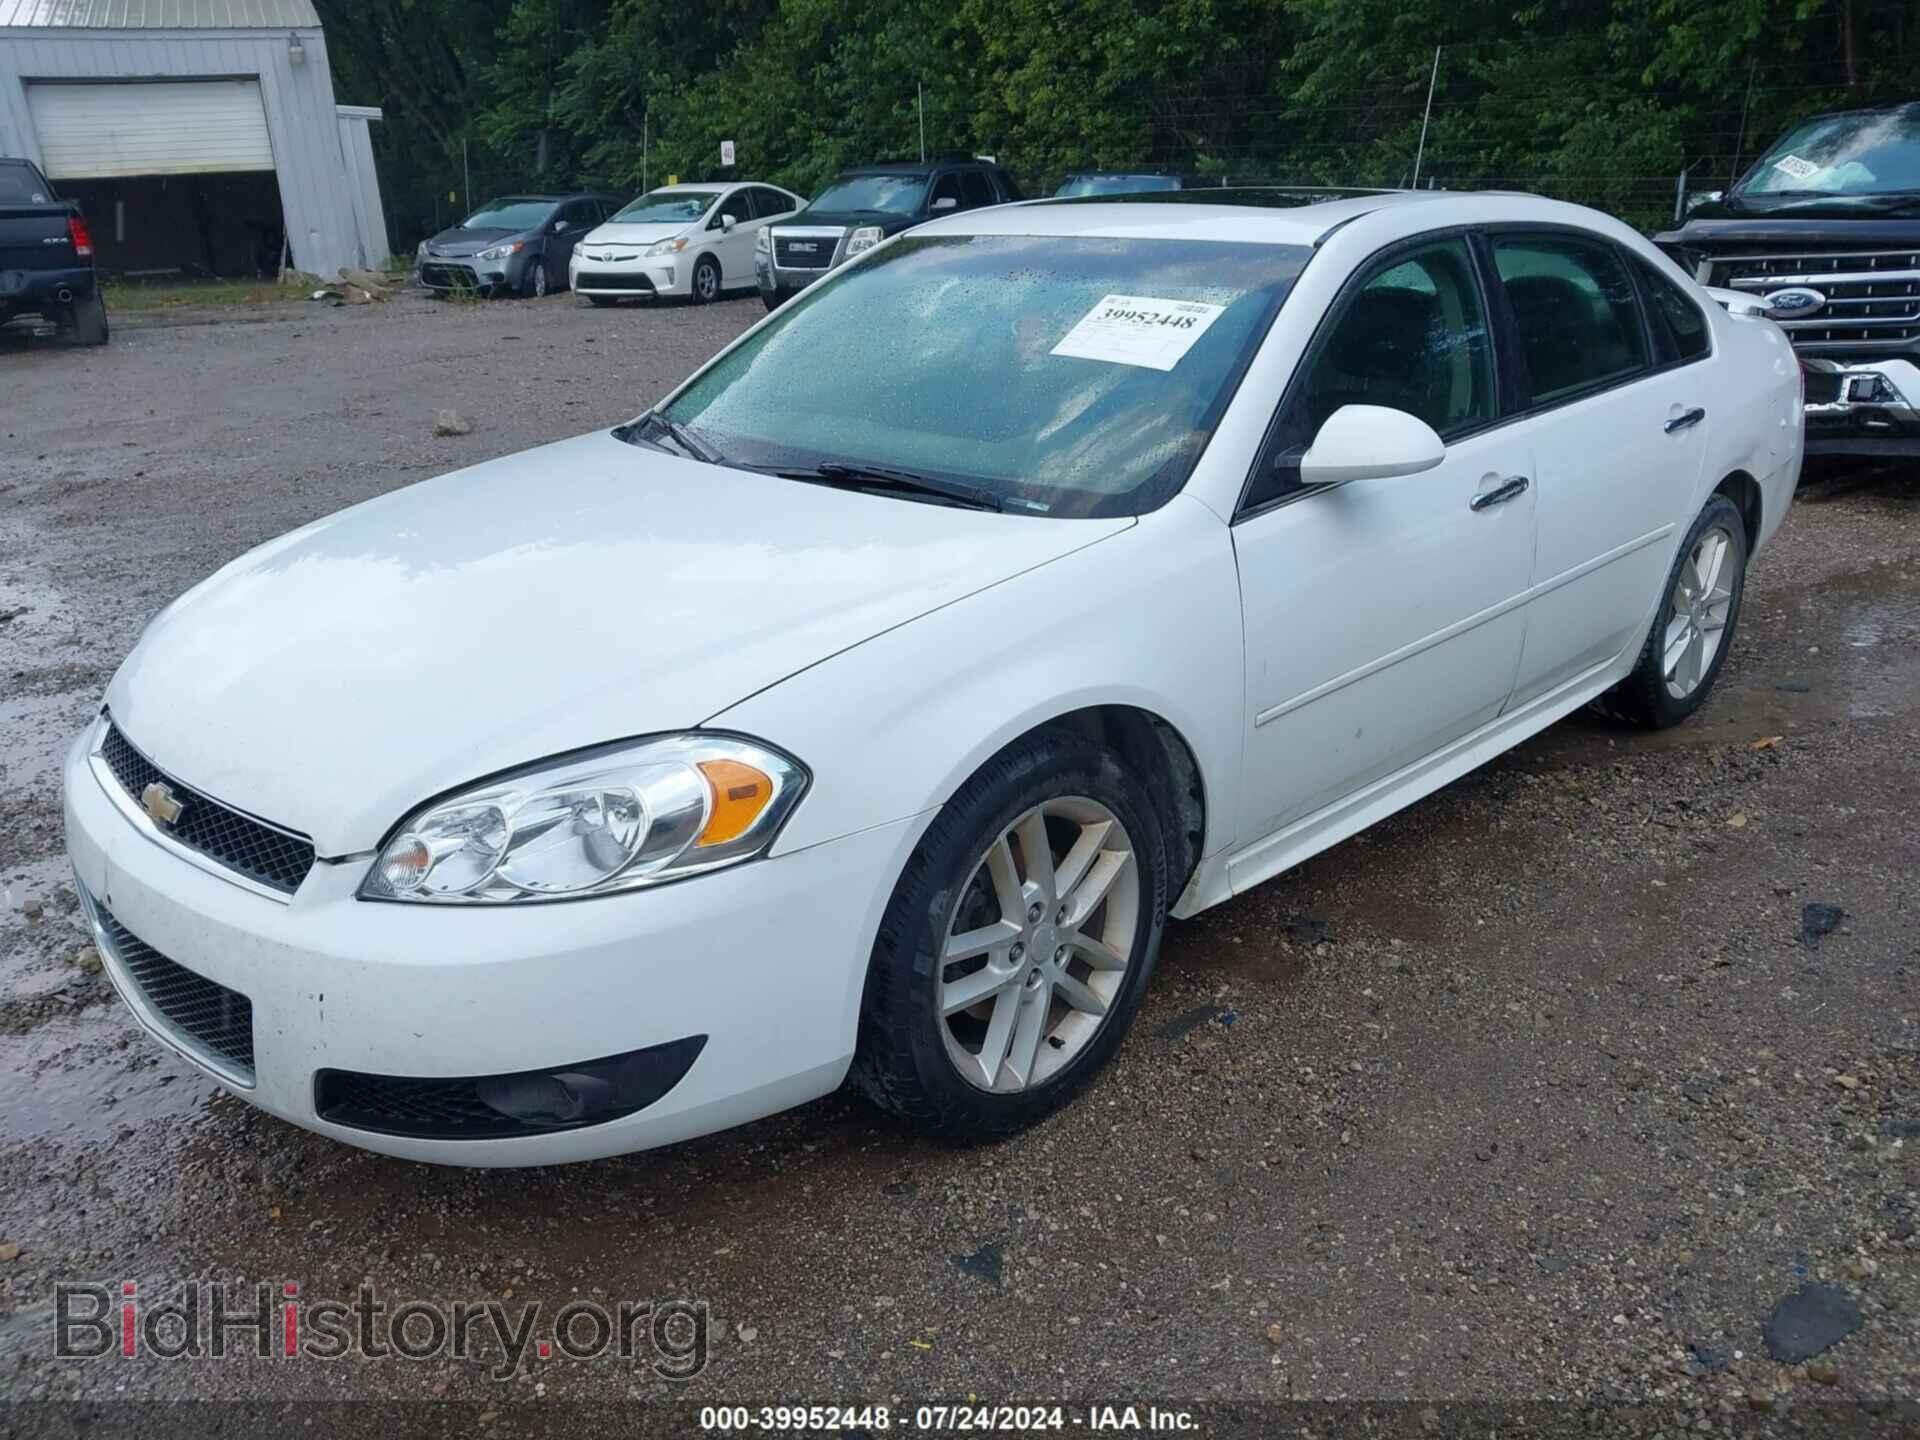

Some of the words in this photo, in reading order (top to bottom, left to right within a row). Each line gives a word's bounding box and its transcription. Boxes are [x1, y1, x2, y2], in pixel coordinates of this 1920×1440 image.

[788, 242, 818, 252] GMC
[1776, 295, 1807, 308] Ford
[1097, 308, 1197, 329] 39952448
